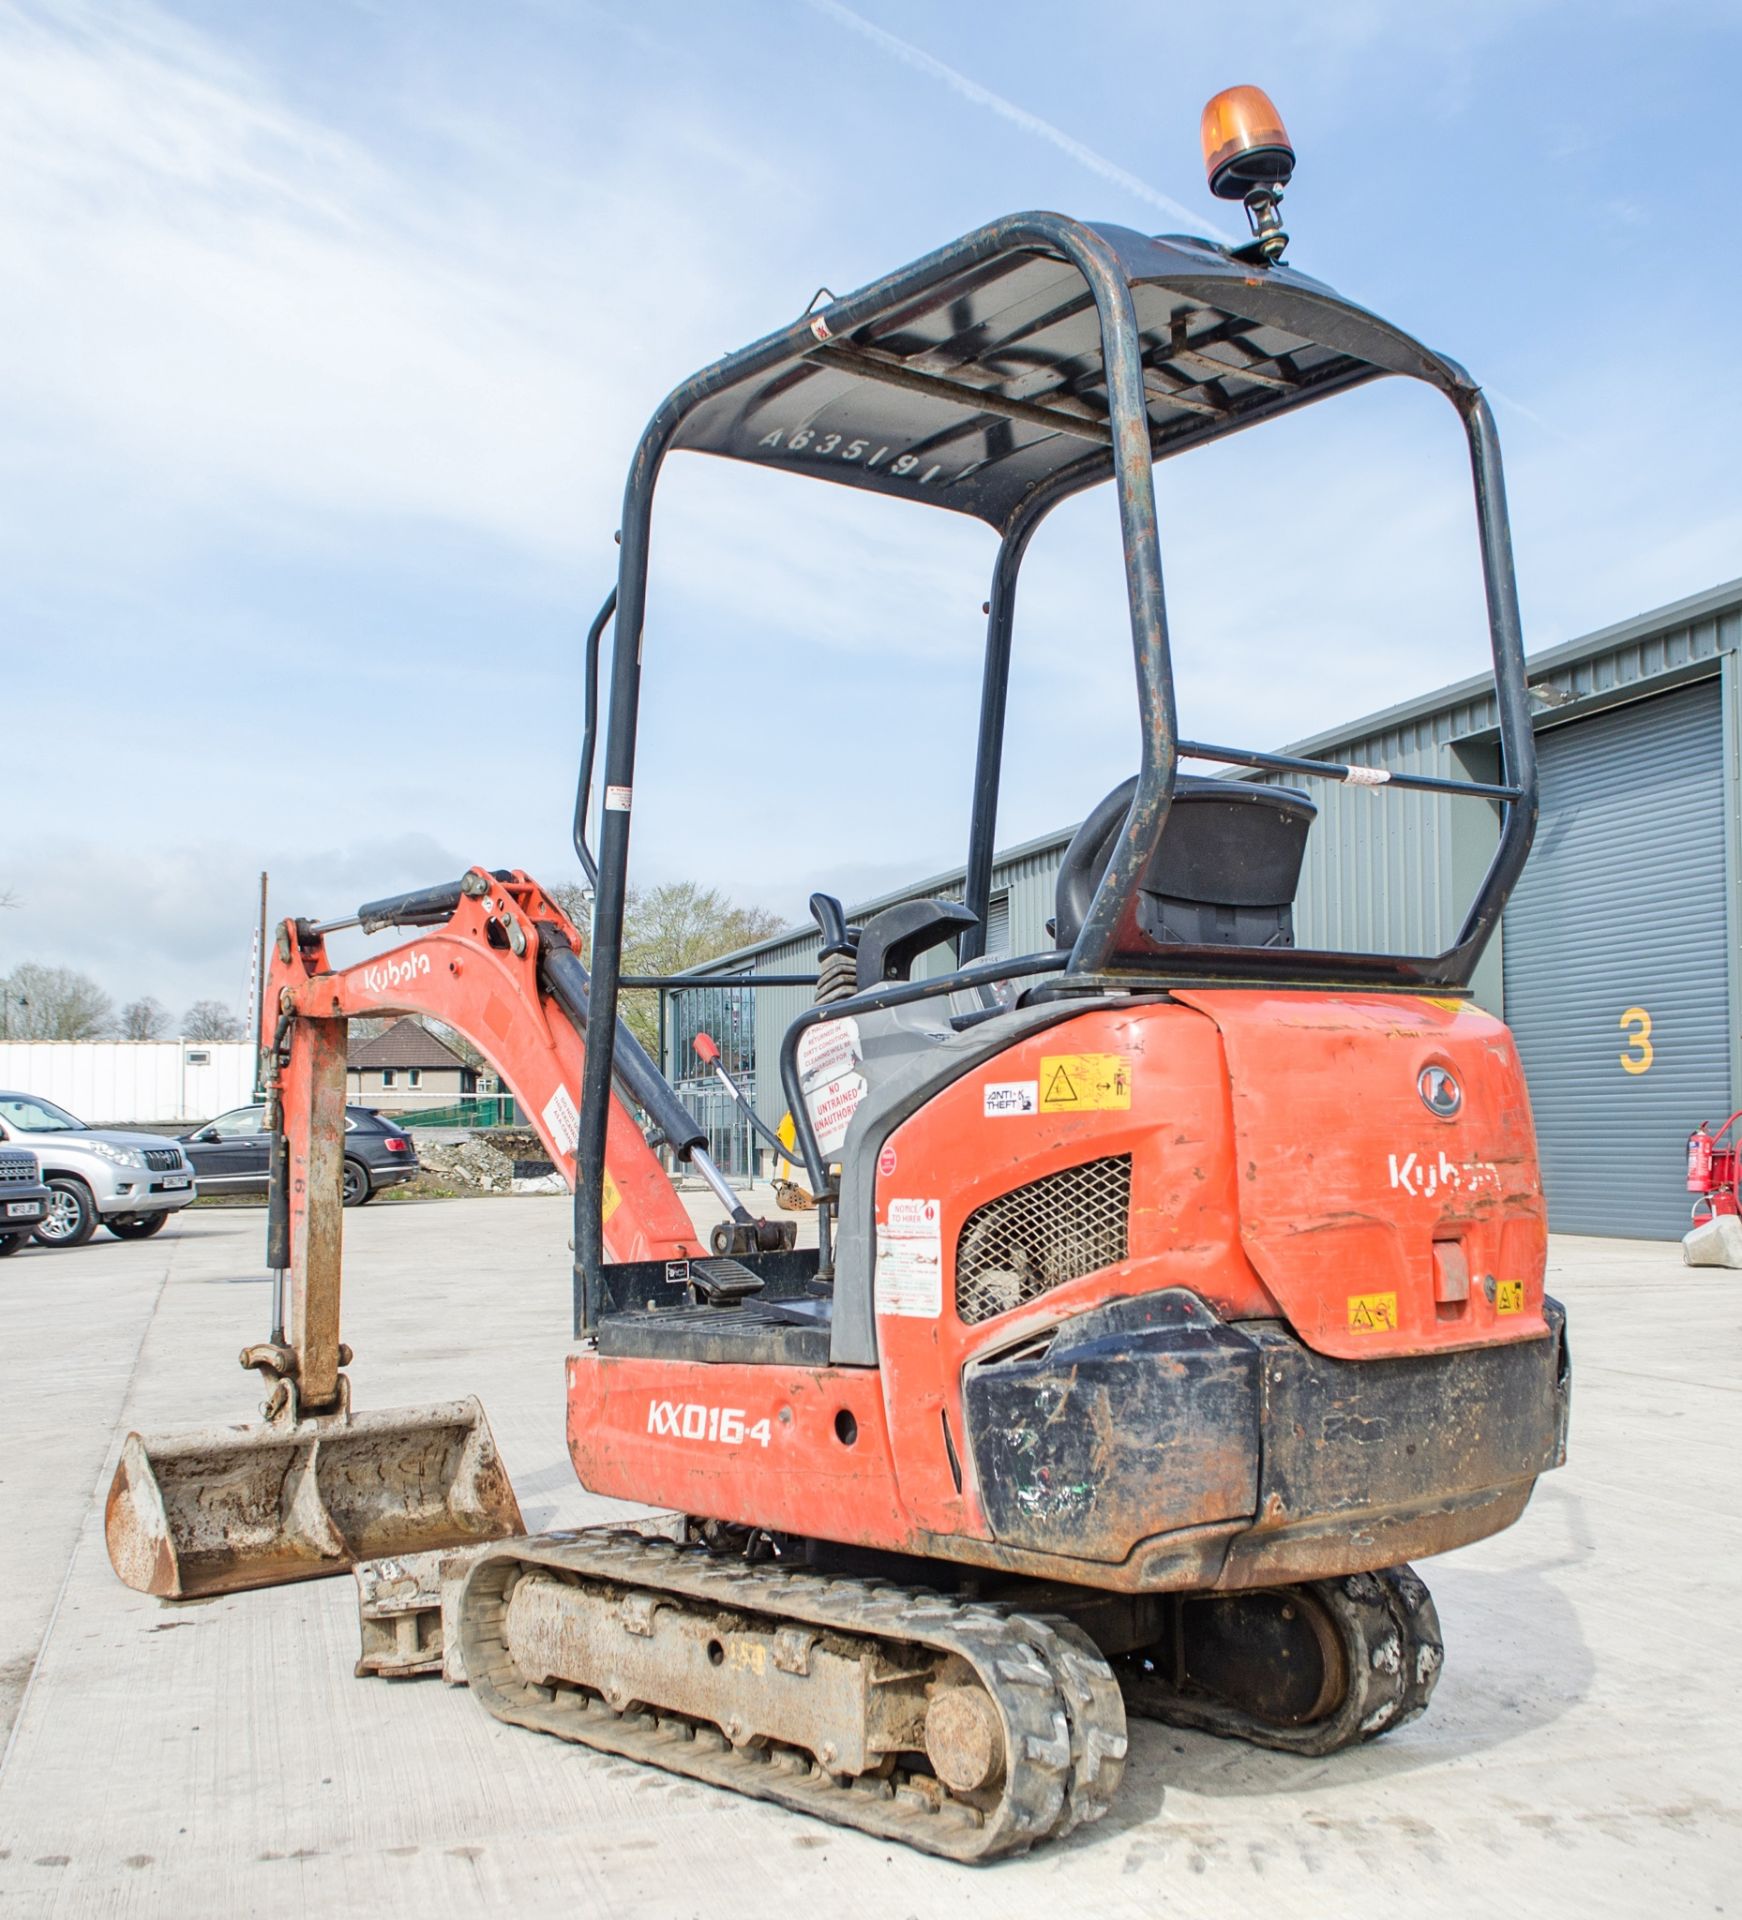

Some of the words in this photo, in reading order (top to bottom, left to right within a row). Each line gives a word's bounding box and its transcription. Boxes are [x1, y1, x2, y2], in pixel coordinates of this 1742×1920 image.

[758, 428, 941, 483] A635191
[363, 950, 432, 993] Kubota
[1618, 1007, 1654, 1075] 3
[816, 1087, 858, 1116] UNTRAINED
[828, 1082, 840, 1095] NO
[987, 1090, 1013, 1100] ANTI
[814, 1102, 858, 1132] UNAUTHORIS
[986, 1099, 1017, 1110] THEFT
[1388, 1151, 1502, 1198] Kub
[892, 1214, 901, 1223] TO
[902, 1214, 921, 1223] HIRER
[894, 1204, 920, 1214] NOTICE
[647, 1399, 772, 1448] KX016-4
